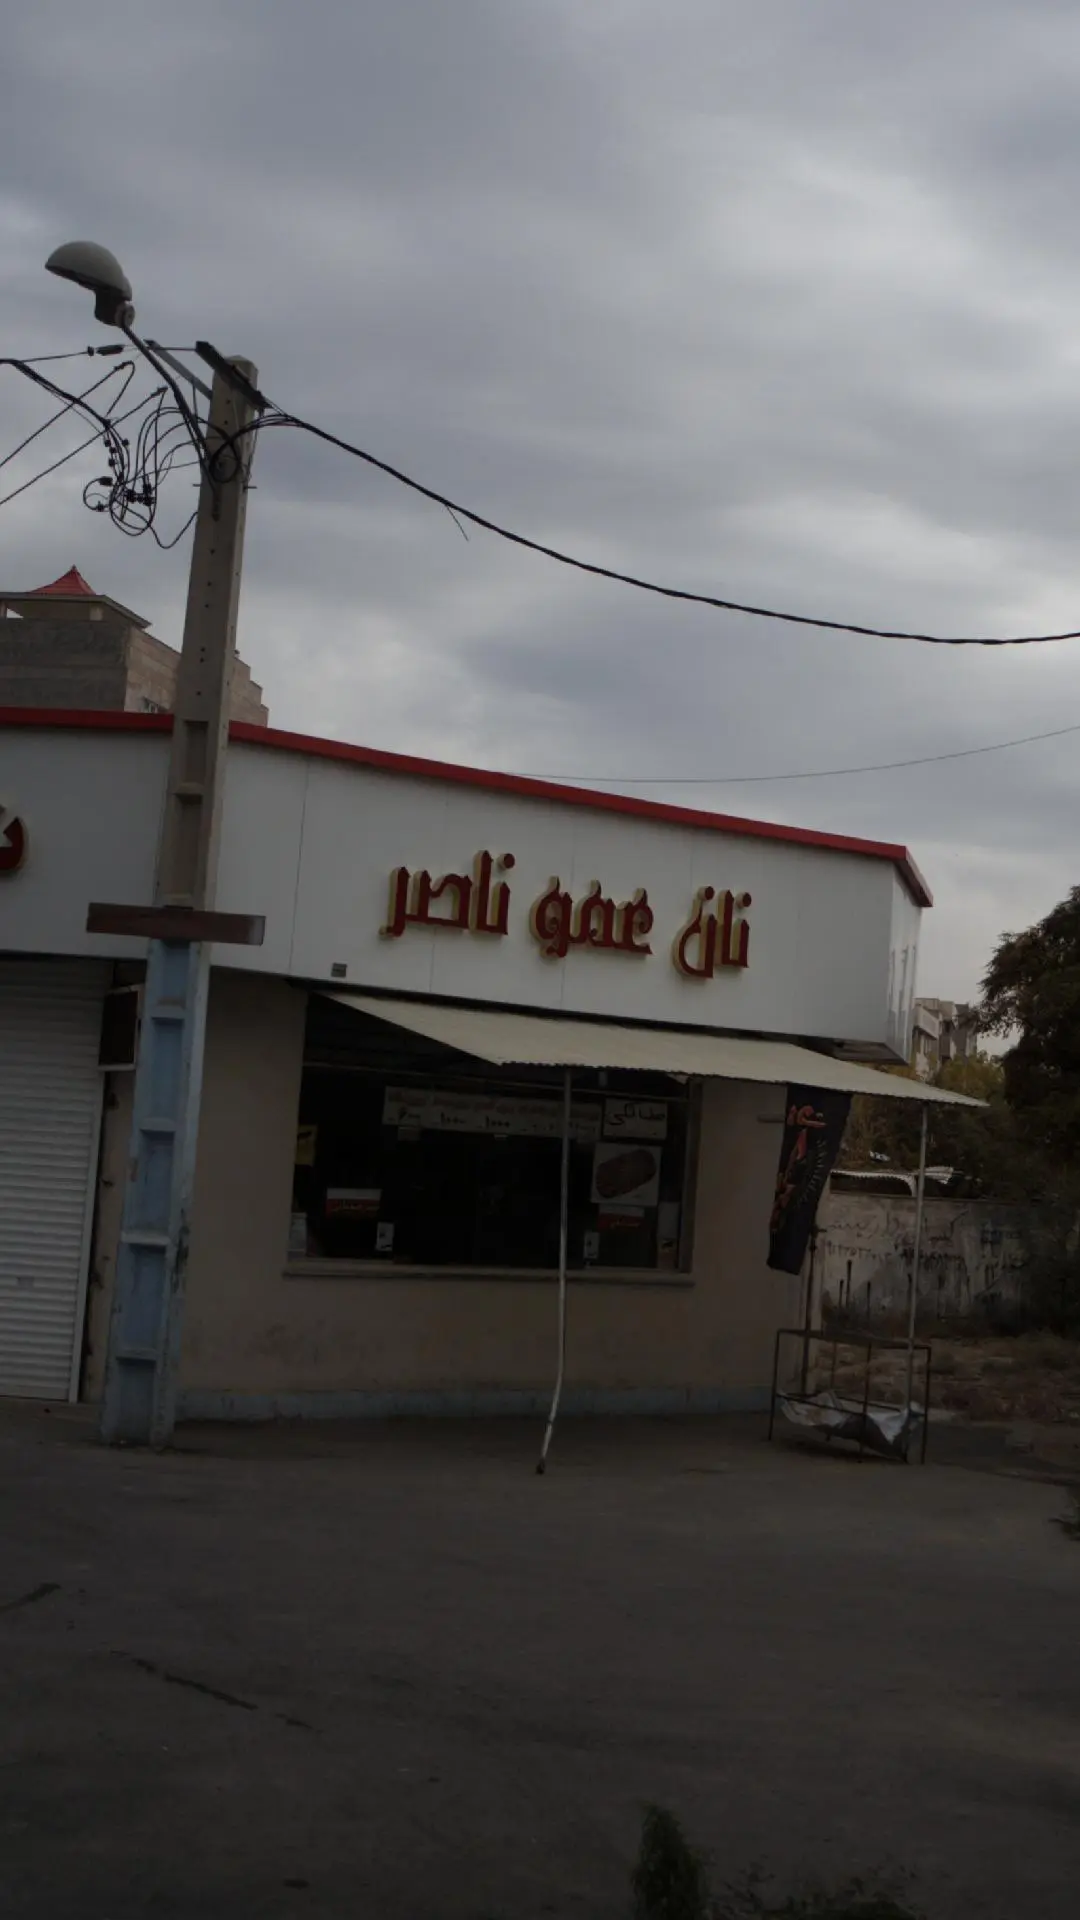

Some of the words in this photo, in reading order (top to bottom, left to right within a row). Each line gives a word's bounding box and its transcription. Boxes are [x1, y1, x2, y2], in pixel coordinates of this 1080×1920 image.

[380, 850, 515, 937] ناصر
[531, 876, 654, 958] عمو
[674, 886, 752, 978] نان
